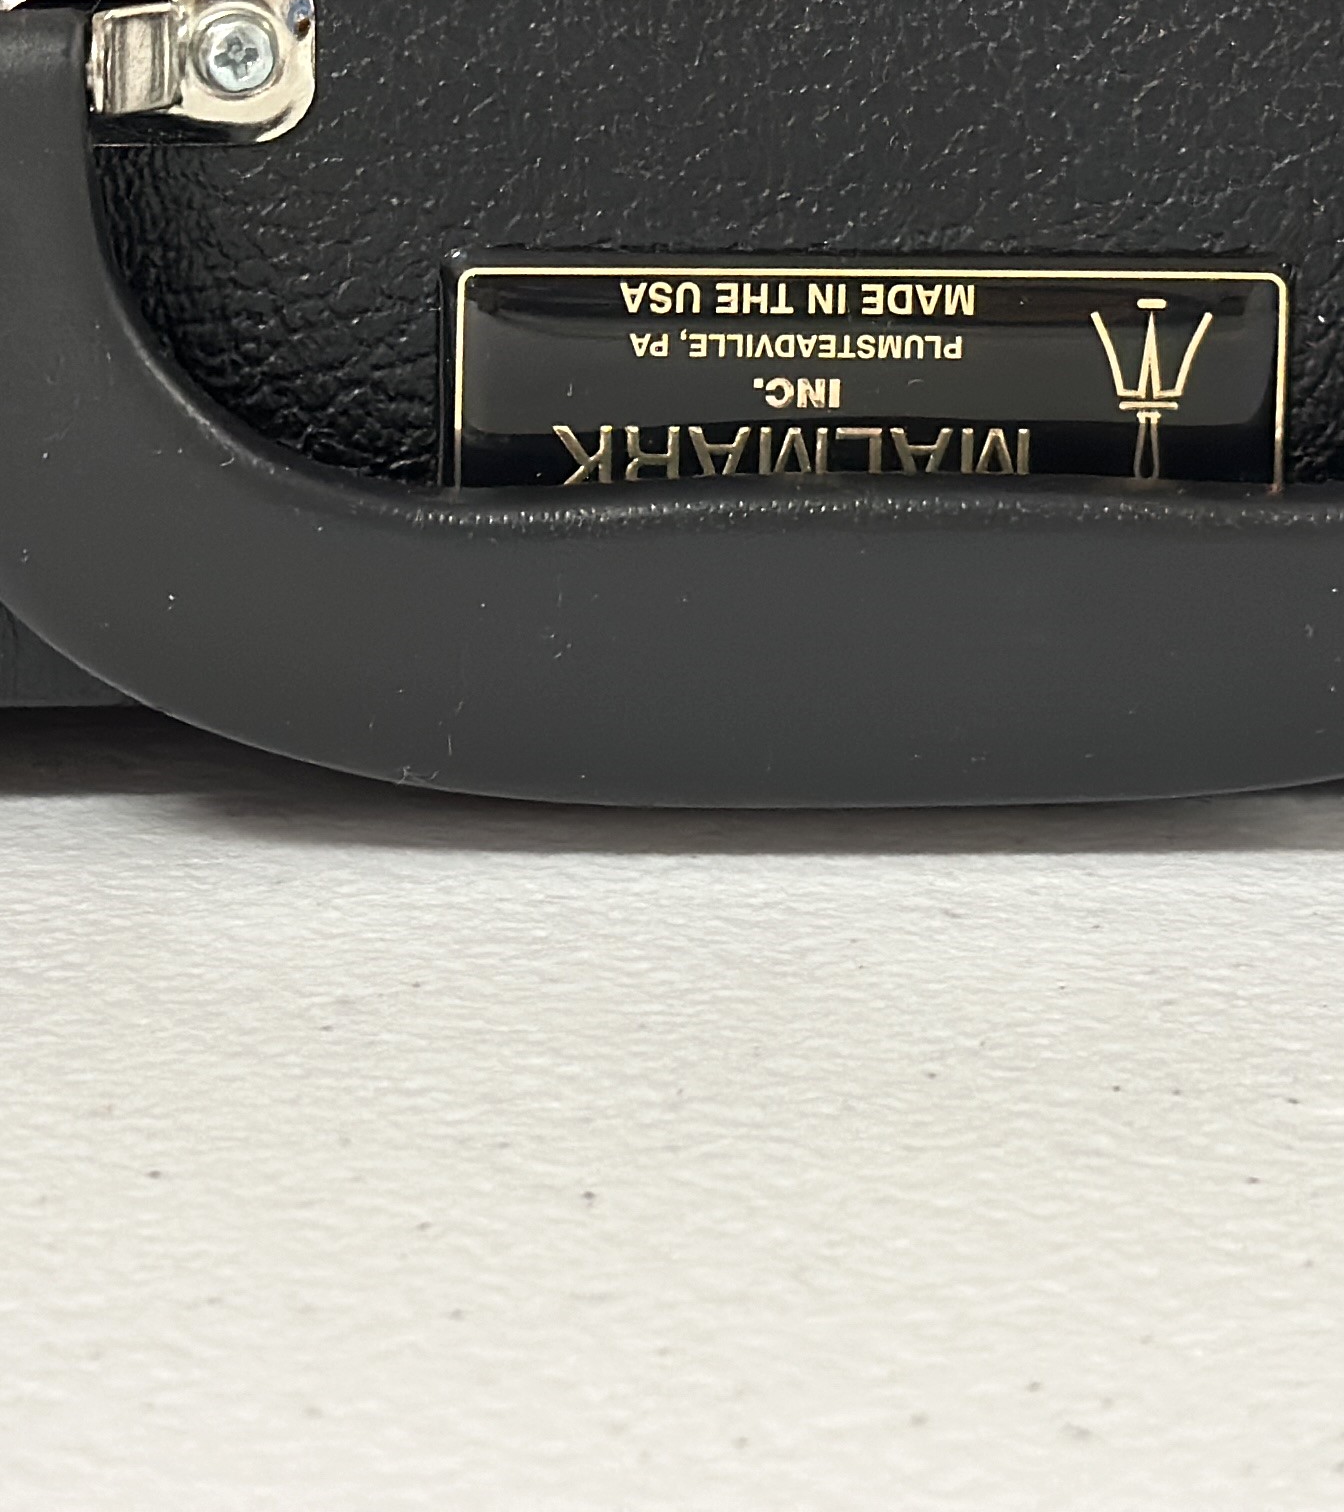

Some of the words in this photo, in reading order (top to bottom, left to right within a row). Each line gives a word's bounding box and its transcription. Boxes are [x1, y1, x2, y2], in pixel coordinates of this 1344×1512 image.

[620, 281, 701, 314] USA
[715, 282, 795, 315] THE
[807, 283, 847, 315] IN
[861, 283, 975, 316] MADE
[629, 332, 669, 358] PA
[679, 329, 963, 360] PLUMSTEADVILLE,
[753, 377, 841, 409] INC.
[552, 424, 1030, 485] MALMARK
